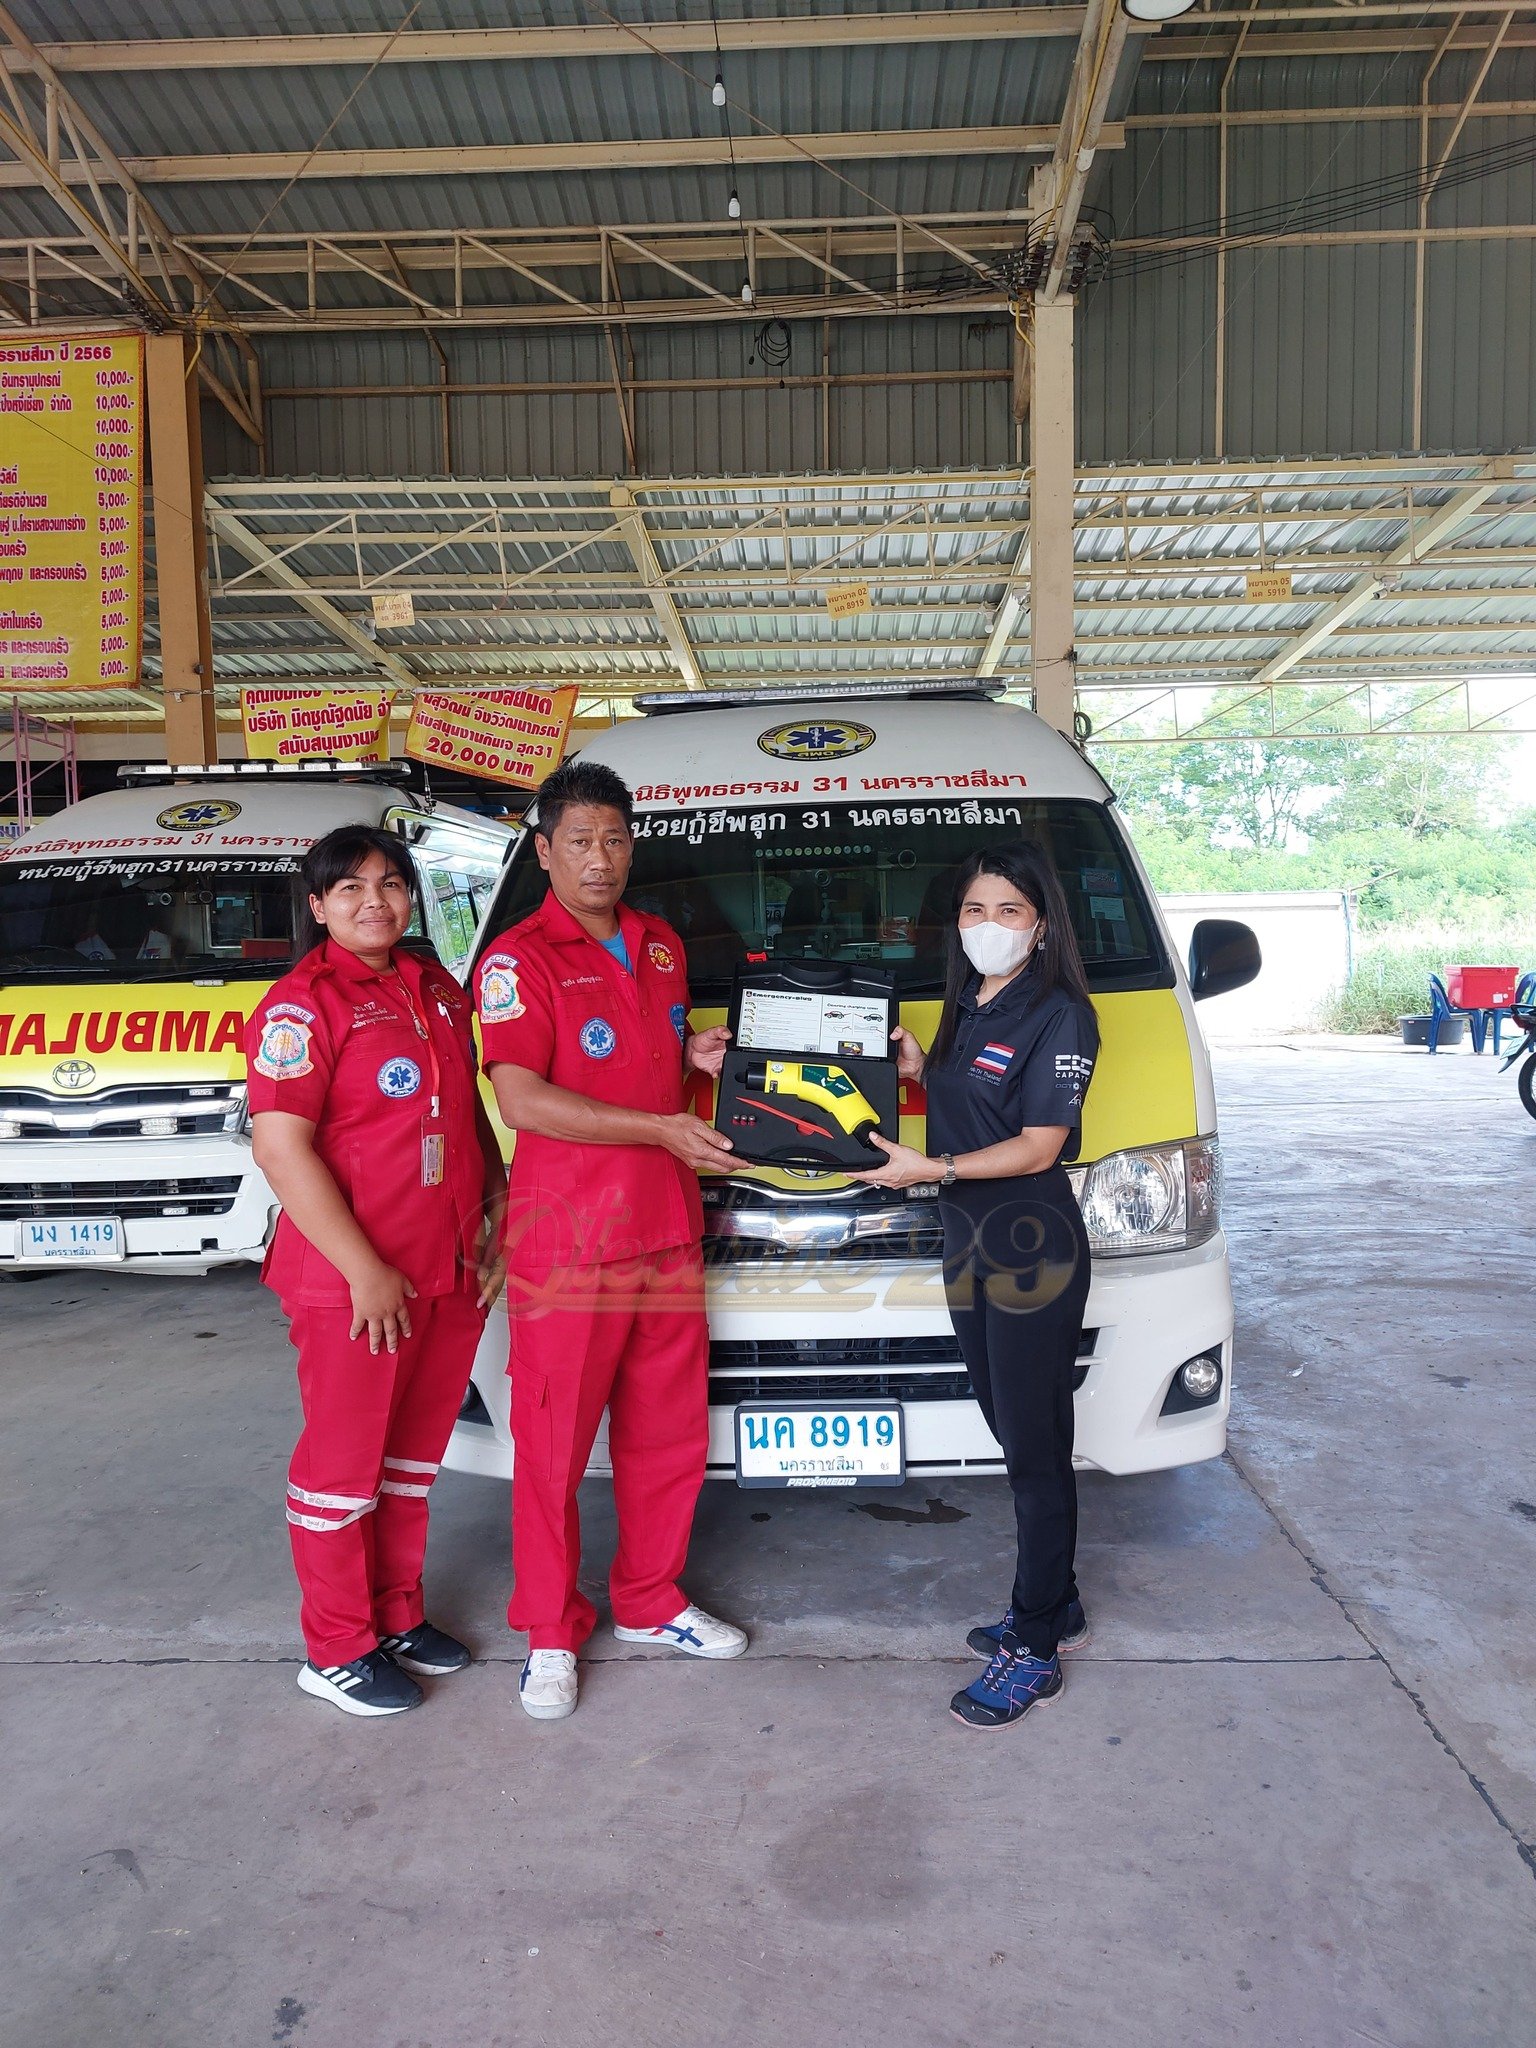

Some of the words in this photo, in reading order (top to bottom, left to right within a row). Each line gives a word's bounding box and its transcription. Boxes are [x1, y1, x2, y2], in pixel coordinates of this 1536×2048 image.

[60, 343, 69, 360] ปี
[74, 346, 112, 360] 2566
[96, 371, 134, 388] 10,000.-
[50, 394, 72, 411] จำกัด
[96, 394, 134, 412] 10,000.-
[96, 418, 134, 435] 10,000.-
[95, 443, 133, 460] 10,000.-
[95, 468, 133, 485] 10,000.-
[98, 492, 130, 510] 5,000.-
[99, 516, 130, 534] 5,000.-
[100, 540, 130, 559] 5,000.-
[29, 562, 87, 581] และครอบครัว
[101, 564, 130, 583] 5,000.-
[101, 588, 130, 607] 5,000.-
[857, 587, 867, 596] 02
[846, 599, 865, 609] 8919
[101, 612, 129, 630] 5,000.-
[11, 636, 69, 654] และครอบครัว
[101, 636, 129, 654] 5,000.-
[11, 661, 68, 679] และครอบครัว
[100, 660, 129, 678] 5,000.-
[248, 709, 287, 733] บริษัท
[426, 736, 500, 770] 20,000
[503, 758, 534, 777] บาท
[629, 781, 799, 805] นิธิพุทธธรรม
[813, 777, 848, 791] 31
[860, 769, 1028, 791] นครราชสีมา
[802, 810, 831, 829] 31
[848, 800, 1022, 828] นครราชสีมา
[191, 833, 213, 845] 31
[268, 1005, 311, 1023] RESCUE
[31, 1225, 57, 1242] นง
[70, 1224, 113, 1241] 1419
[745, 1416, 795, 1450] นค
[810, 1415, 894, 1448] 8919
[780, 1455, 864, 1472] นครราชสีมา
